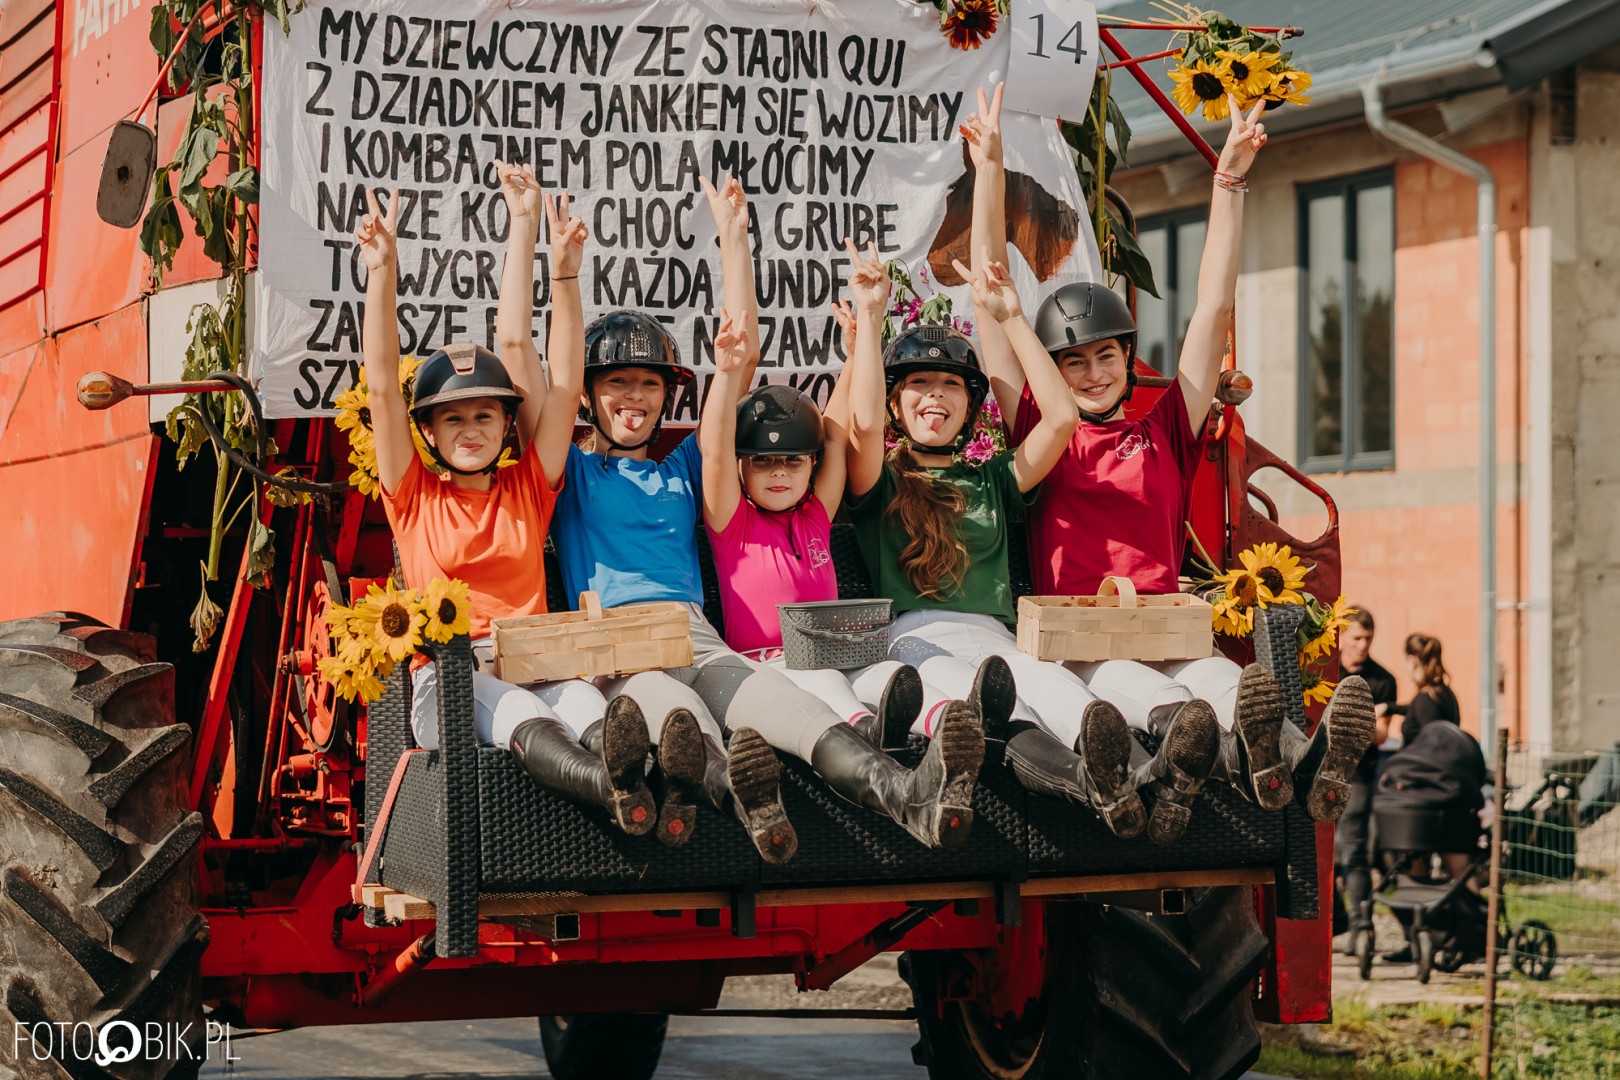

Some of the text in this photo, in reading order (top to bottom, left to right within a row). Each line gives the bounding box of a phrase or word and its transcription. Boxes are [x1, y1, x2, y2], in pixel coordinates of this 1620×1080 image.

[319, 7, 906, 88] MY DZIEWCZYNY ZE STAJNI QUI
[1027, 13, 1088, 64] 14
[305, 62, 963, 143] Z DZIADKIEM JANKIEM SIĘ WOZIMY
[320, 122, 875, 198] I KOMBAJNEM POLA MŁÓCIMY
[594, 193, 694, 250] CHOĆ
[775, 201, 901, 254] GRUBE
[593, 250, 714, 315] KAŻDĄ
[307, 299, 467, 356] ZASZE
